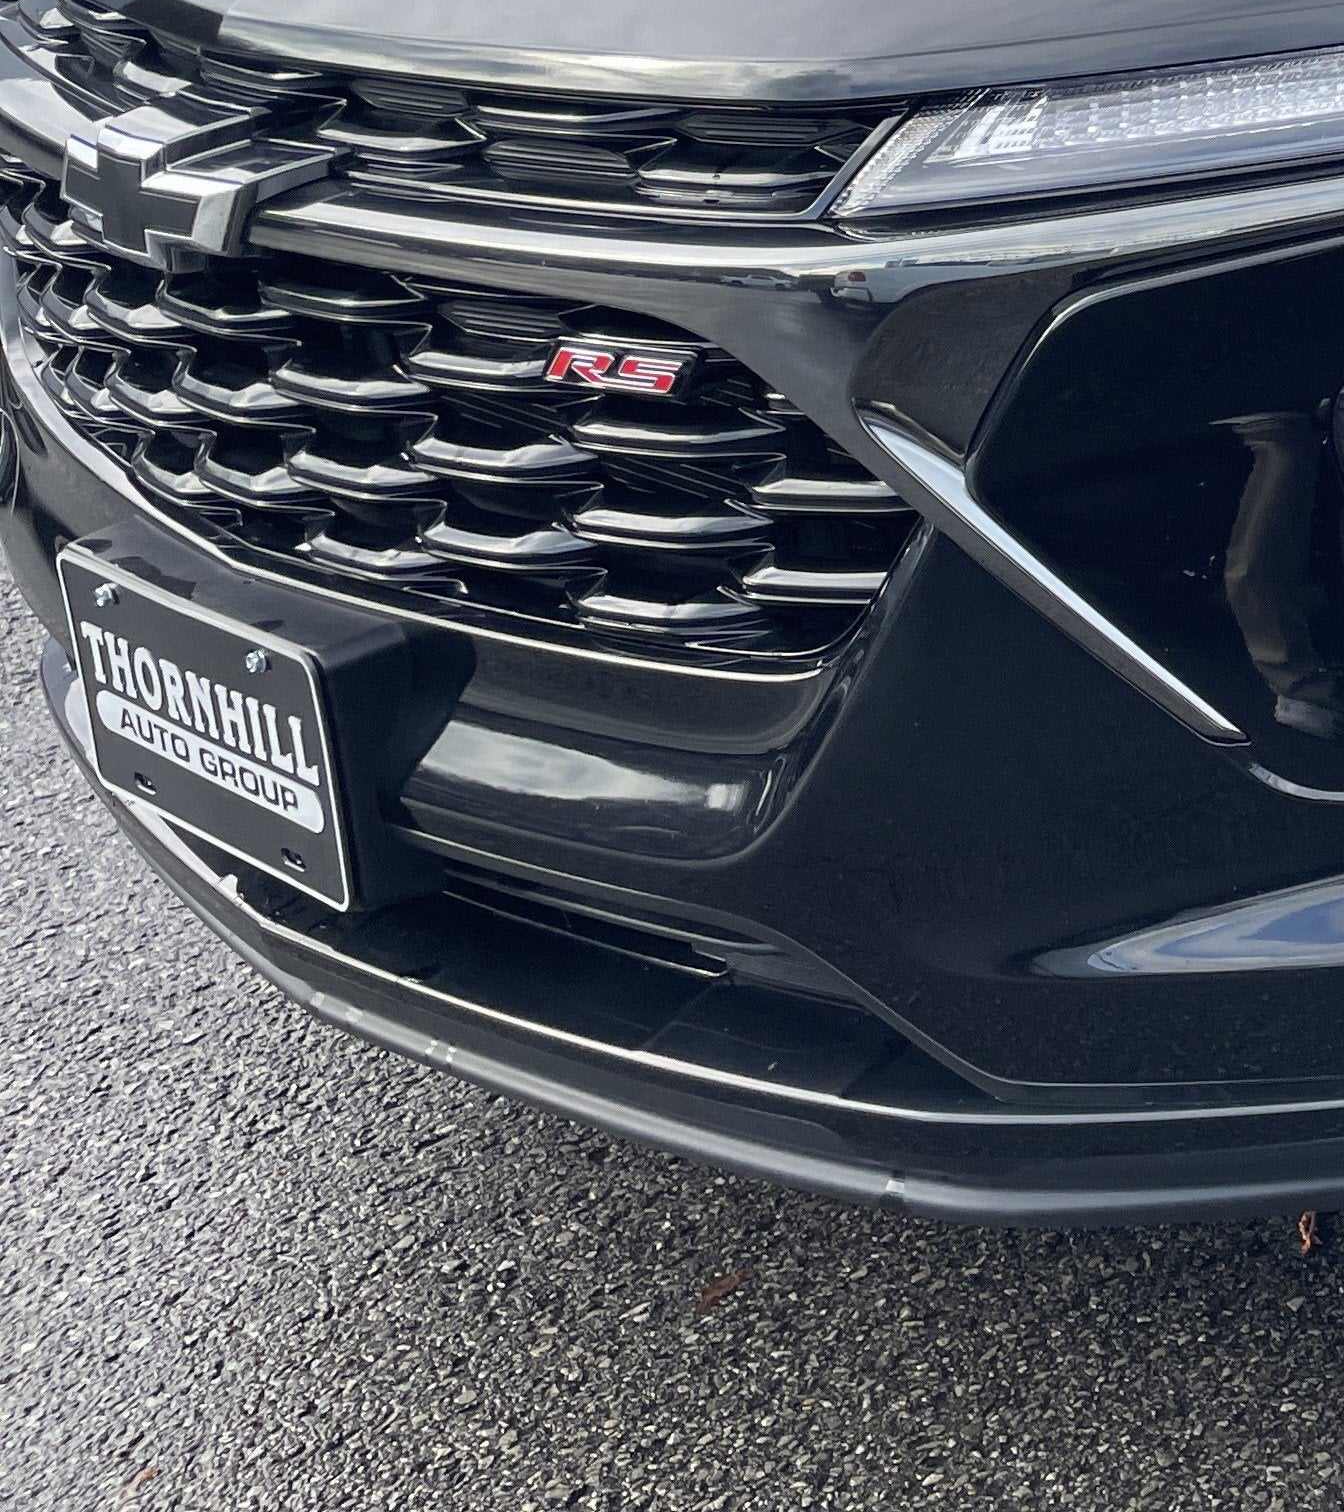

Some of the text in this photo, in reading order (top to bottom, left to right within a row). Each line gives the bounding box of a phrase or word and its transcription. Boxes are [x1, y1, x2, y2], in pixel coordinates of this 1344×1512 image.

[546, 345, 685, 395] RS
[80, 620, 321, 787] THORNHILL
[119, 706, 300, 814] AUTO GROUP
